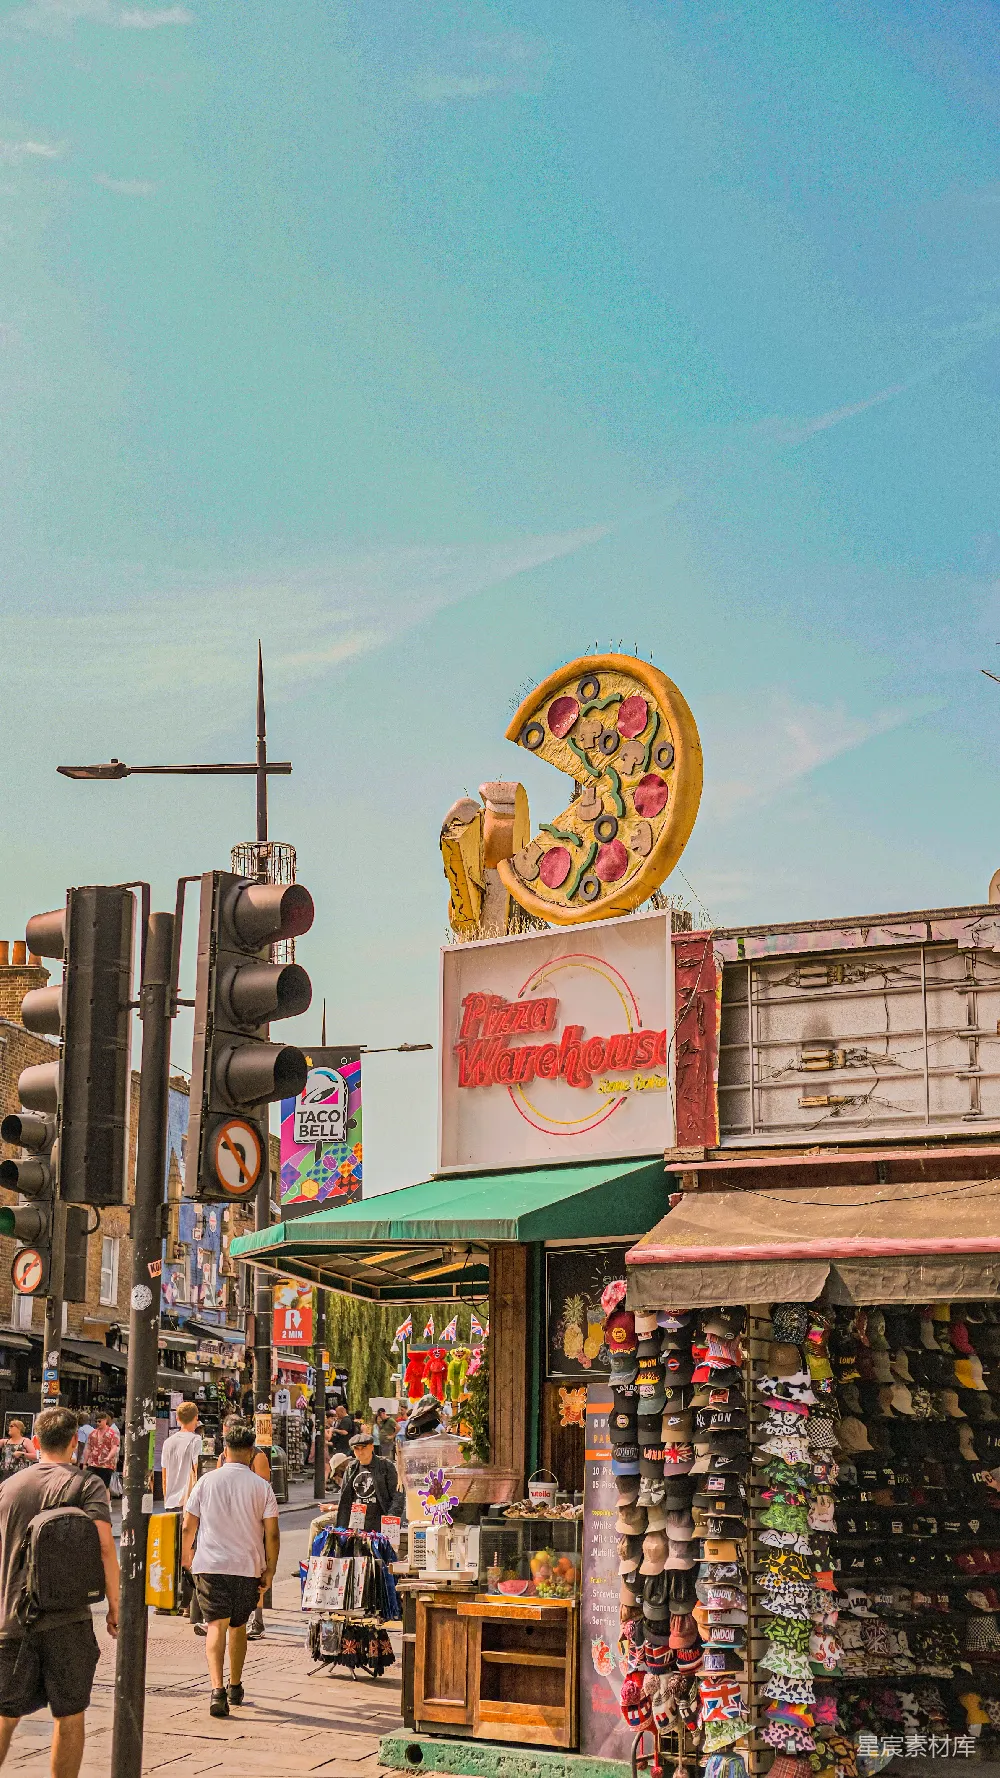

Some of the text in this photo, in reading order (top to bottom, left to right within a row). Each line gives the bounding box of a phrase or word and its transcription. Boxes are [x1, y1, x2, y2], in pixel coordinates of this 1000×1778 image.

[459, 992, 559, 1039] Pizza
[297, 1109, 341, 1124] TACO
[299, 1124, 339, 1138] BELL
[282, 1330, 303, 1339] 2 MIN
[592, 1466, 600, 1475] 10
[592, 1480, 600, 1489] 15
